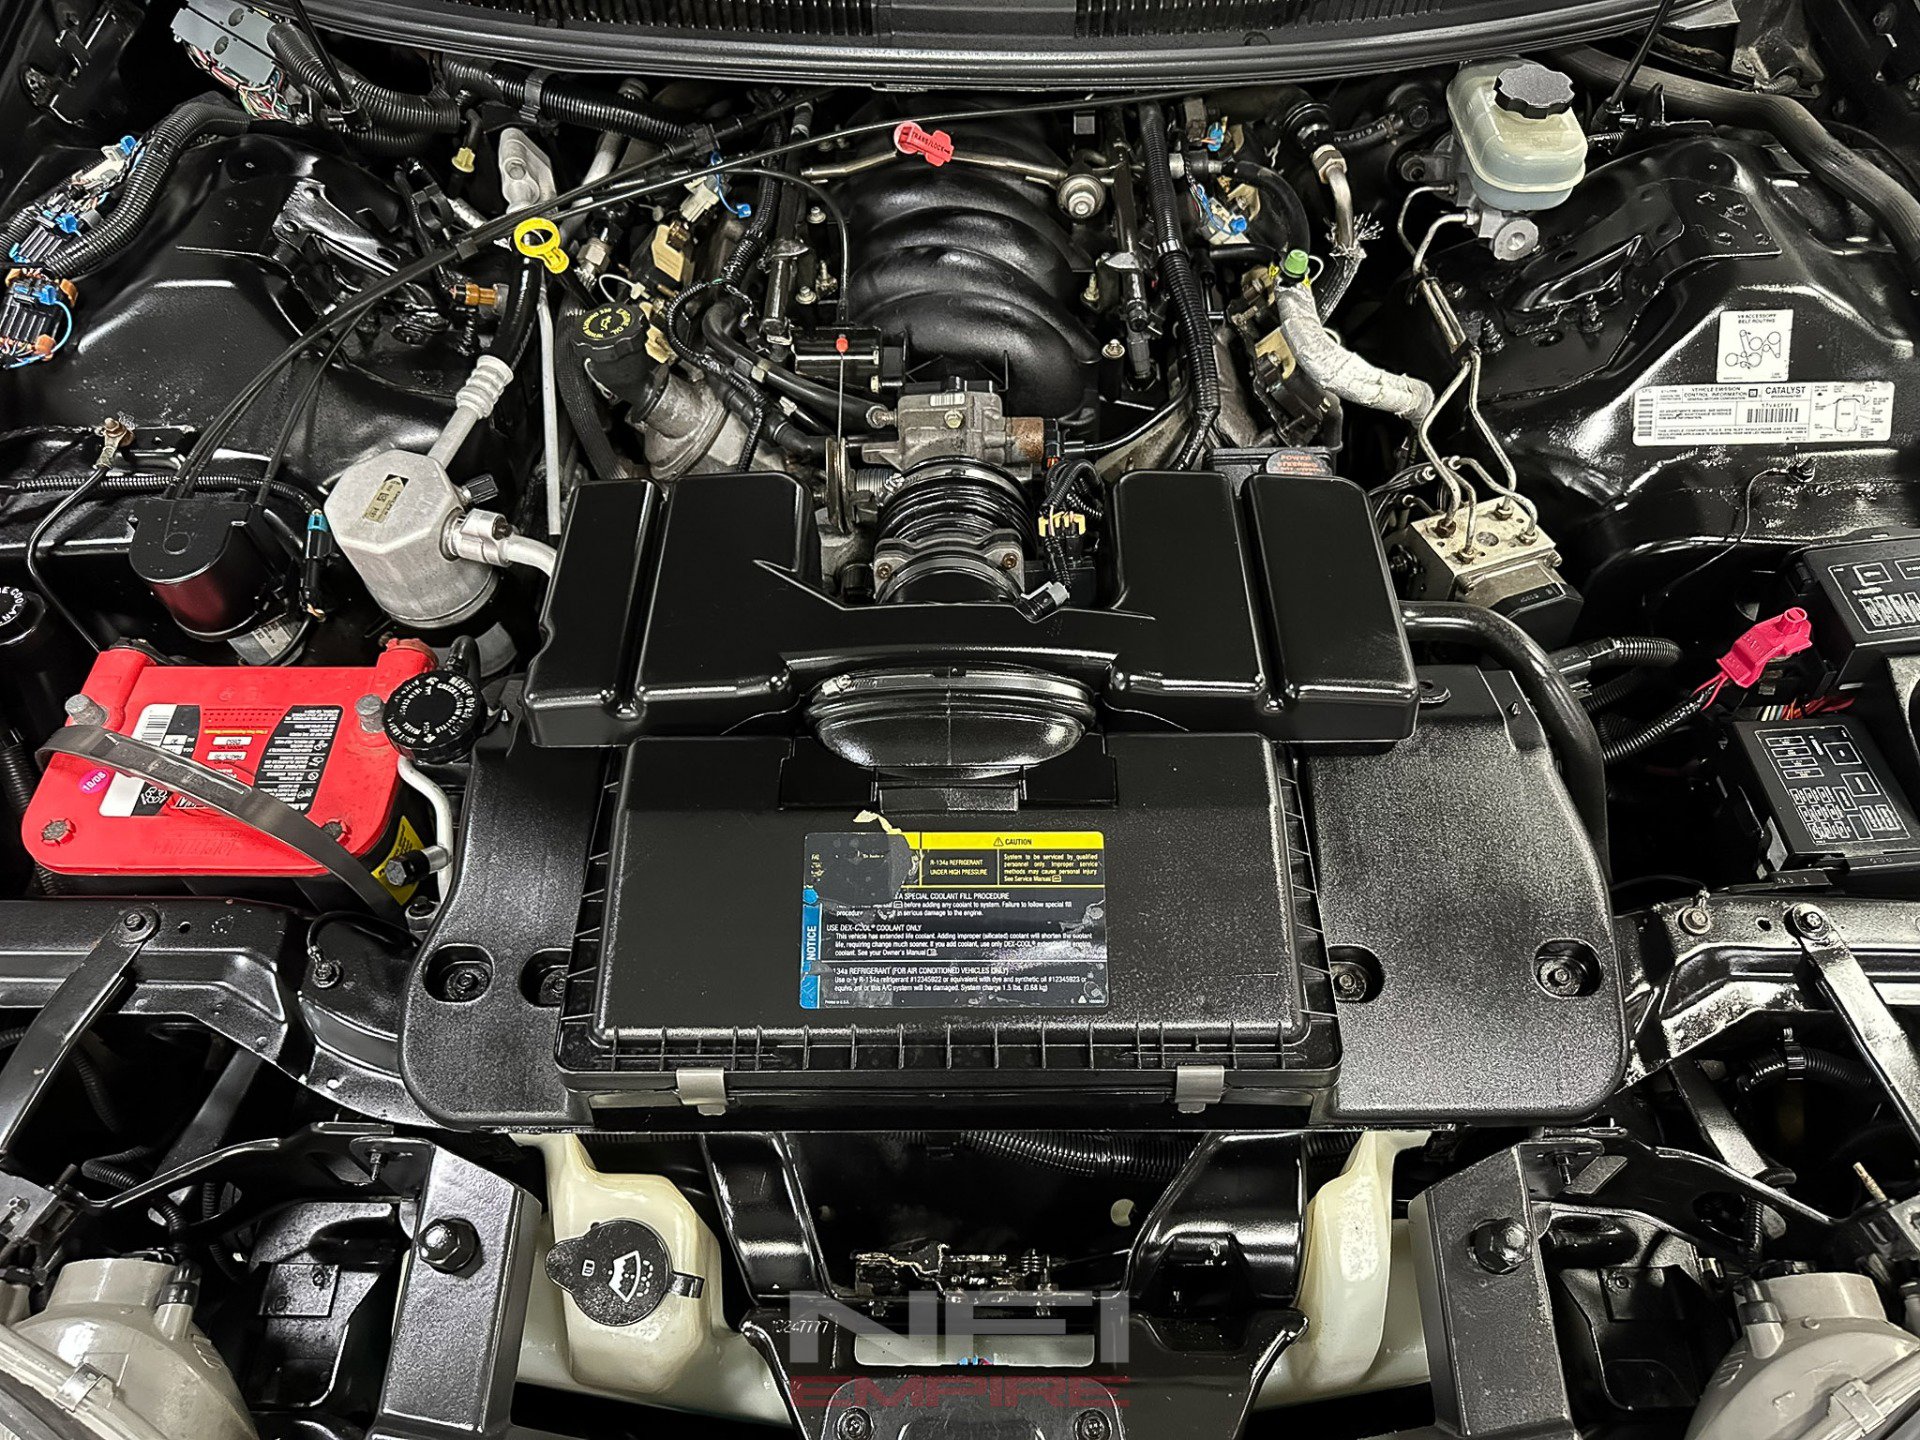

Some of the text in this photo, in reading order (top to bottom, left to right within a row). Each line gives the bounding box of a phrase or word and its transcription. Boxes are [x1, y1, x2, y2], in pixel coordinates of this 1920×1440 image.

[912, 132, 945, 152] TRANS/LOCK
[1765, 386, 1806, 394] CATALYST
[82, 771, 106, 792] 10/08
[1005, 838, 1032, 846] CAUTION
[1004, 853, 1022, 861] System
[1043, 853, 1064, 861] serviced
[1076, 853, 1098, 861] qualified
[836, 932, 847, 940] This
[848, 932, 867, 940] vehicle
[868, 932, 878, 940] has
[880, 932, 904, 940] extended
[905, 932, 914, 940] life
[915, 932, 935, 940] coolant.
[937, 932, 956, 940] Adding
[1010, 932, 1029, 940] coolant
[1030, 932, 1040, 940] will
[1041, 932, 1061, 940] shorten
[806, 925, 817, 960] NOTICE
[849, 967, 891, 975] REFRIGERANT
[892, 967, 906, 975] (FOR
[907, 967, 918, 975] AIR
[918, 967, 960, 975] CONDITIONED
[960, 967, 989, 975] VEHICLES
